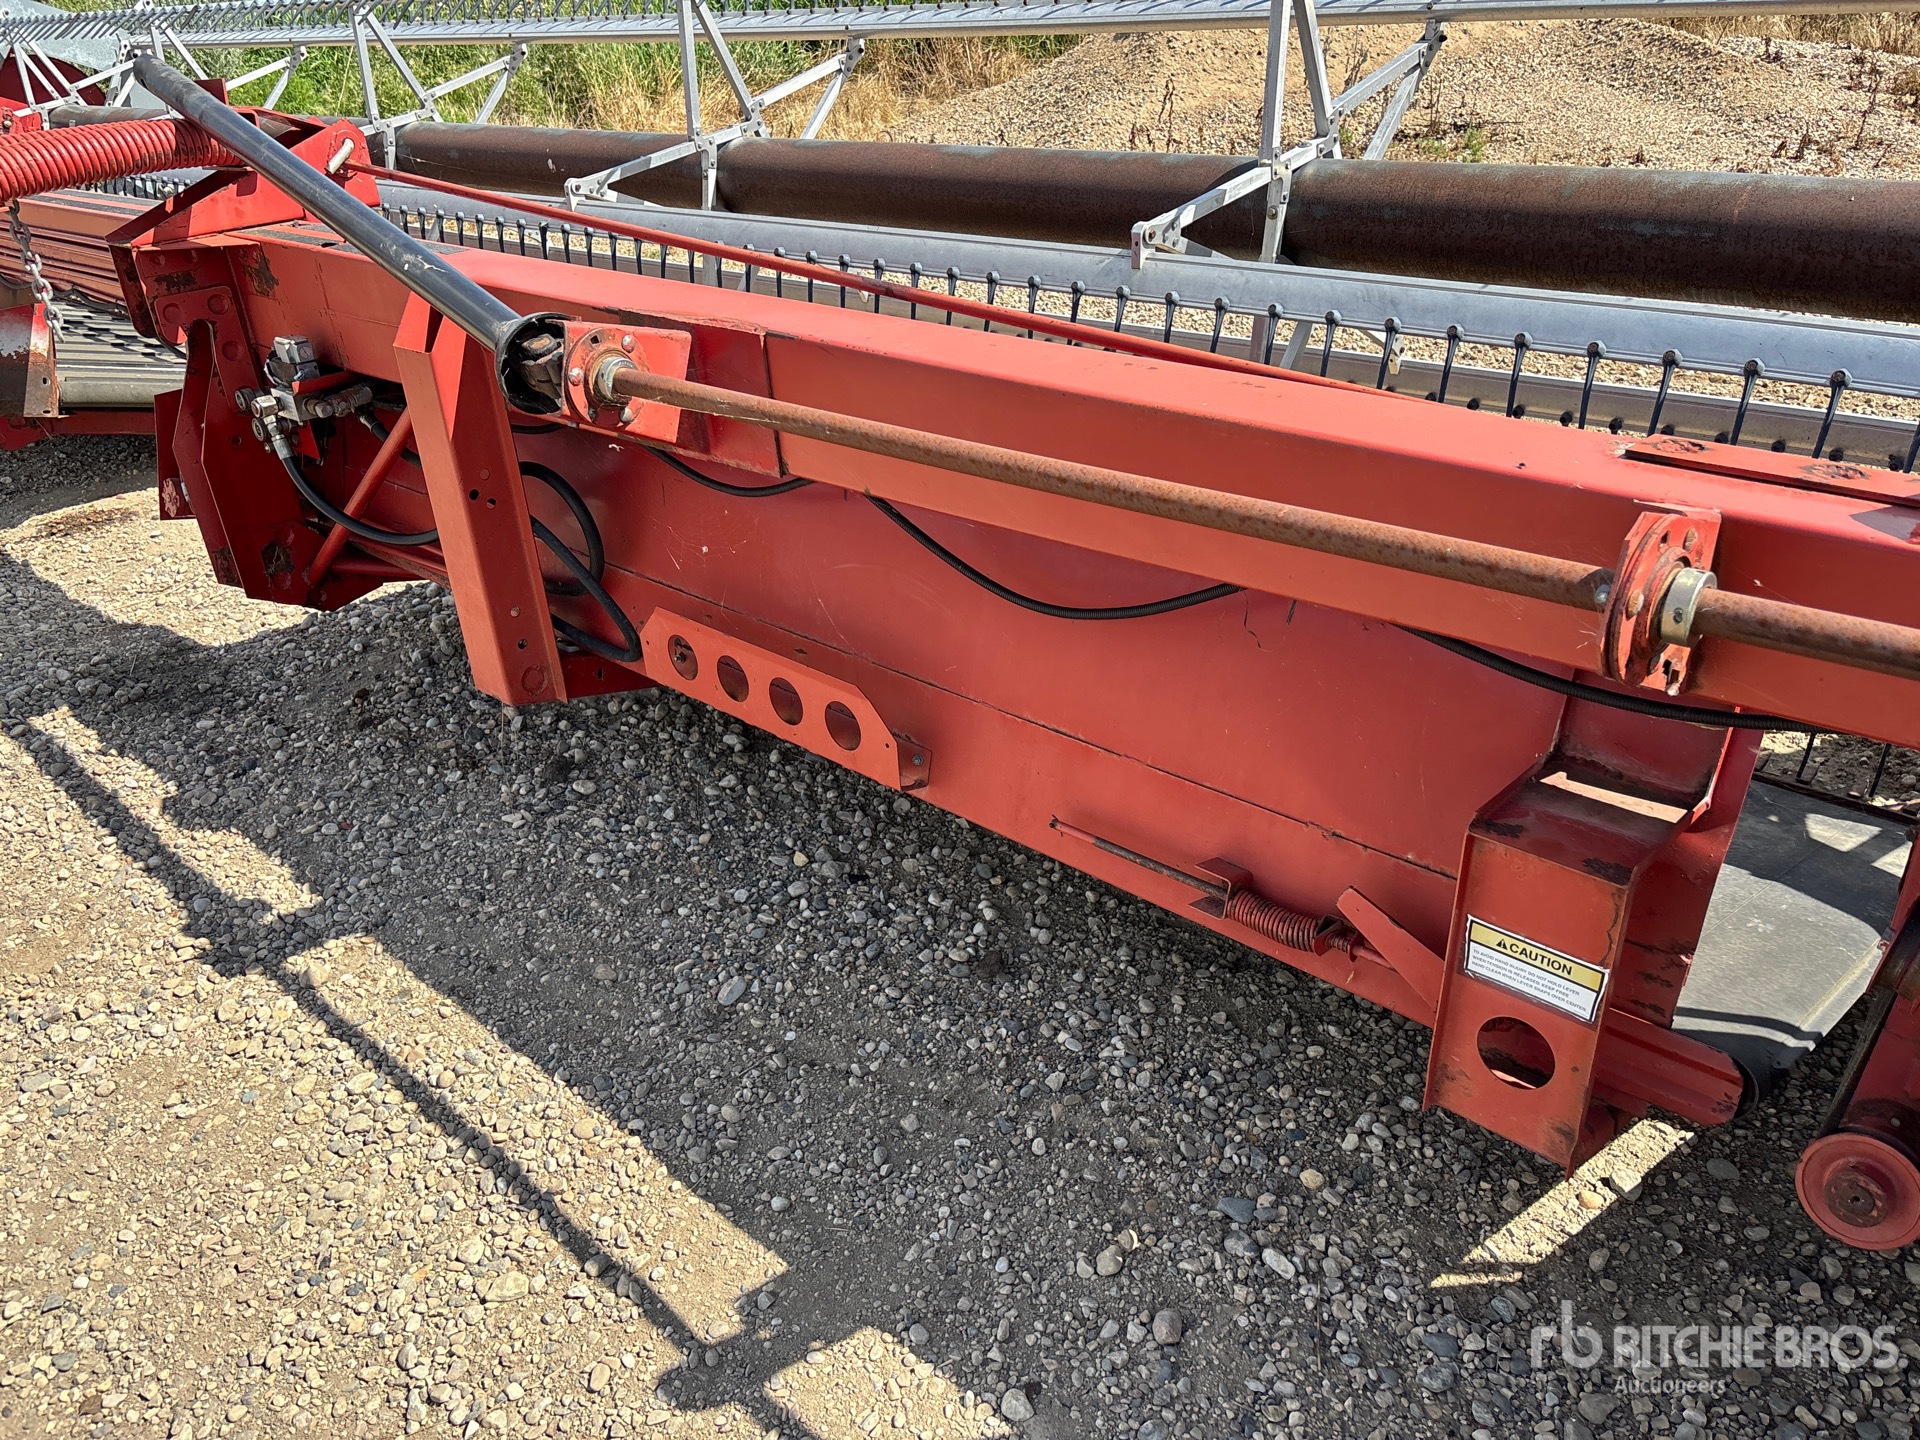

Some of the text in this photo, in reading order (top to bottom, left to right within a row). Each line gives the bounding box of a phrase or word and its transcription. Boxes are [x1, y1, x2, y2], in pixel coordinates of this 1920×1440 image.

[1472, 955, 1487, 963] WHEN
[1487, 960, 1508, 972] TENSION
[1541, 983, 1555, 993] KEEP
[1555, 989, 1569, 998] FREE
[1480, 952, 1494, 960] AVOID
[1494, 958, 1509, 966] HAND
[1536, 974, 1547, 982] NOT
[1547, 979, 1562, 988] HOLD
[1510, 943, 1573, 976] CAUTION
[1472, 961, 1485, 969] HAND
[1485, 966, 1502, 975] CLEAR
[1502, 973, 1517, 982] WHEN
[1517, 978, 1533, 988] LEVER
[1534, 985, 1551, 996] SNAPS
[1551, 993, 1566, 1003] OVER
